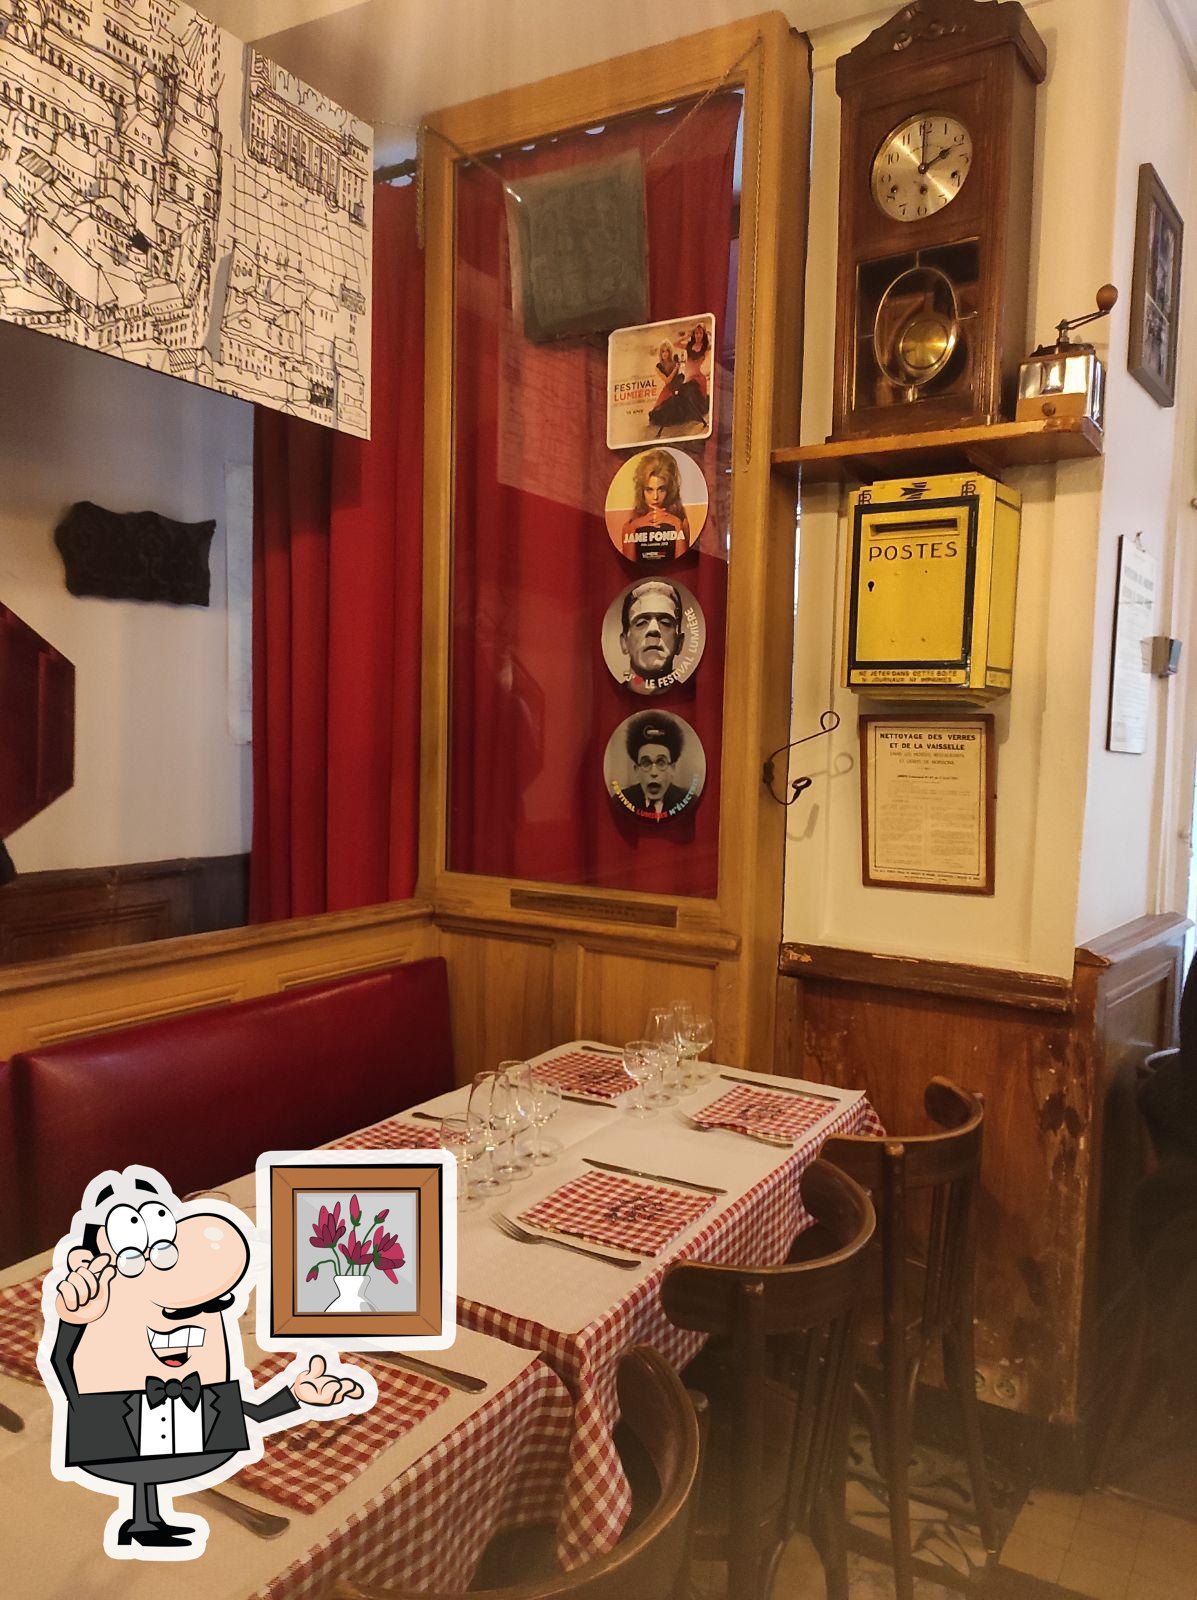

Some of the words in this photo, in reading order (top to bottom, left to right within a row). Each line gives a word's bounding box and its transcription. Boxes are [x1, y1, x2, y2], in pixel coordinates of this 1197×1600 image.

[614, 380, 657, 392] FESTIVAL
[624, 532, 648, 543] JANE
[649, 530, 685, 542] FONDA
[869, 541, 958, 562] POSTES
[645, 680, 655, 689] LE
[658, 657, 693, 688] FESTIVAL
